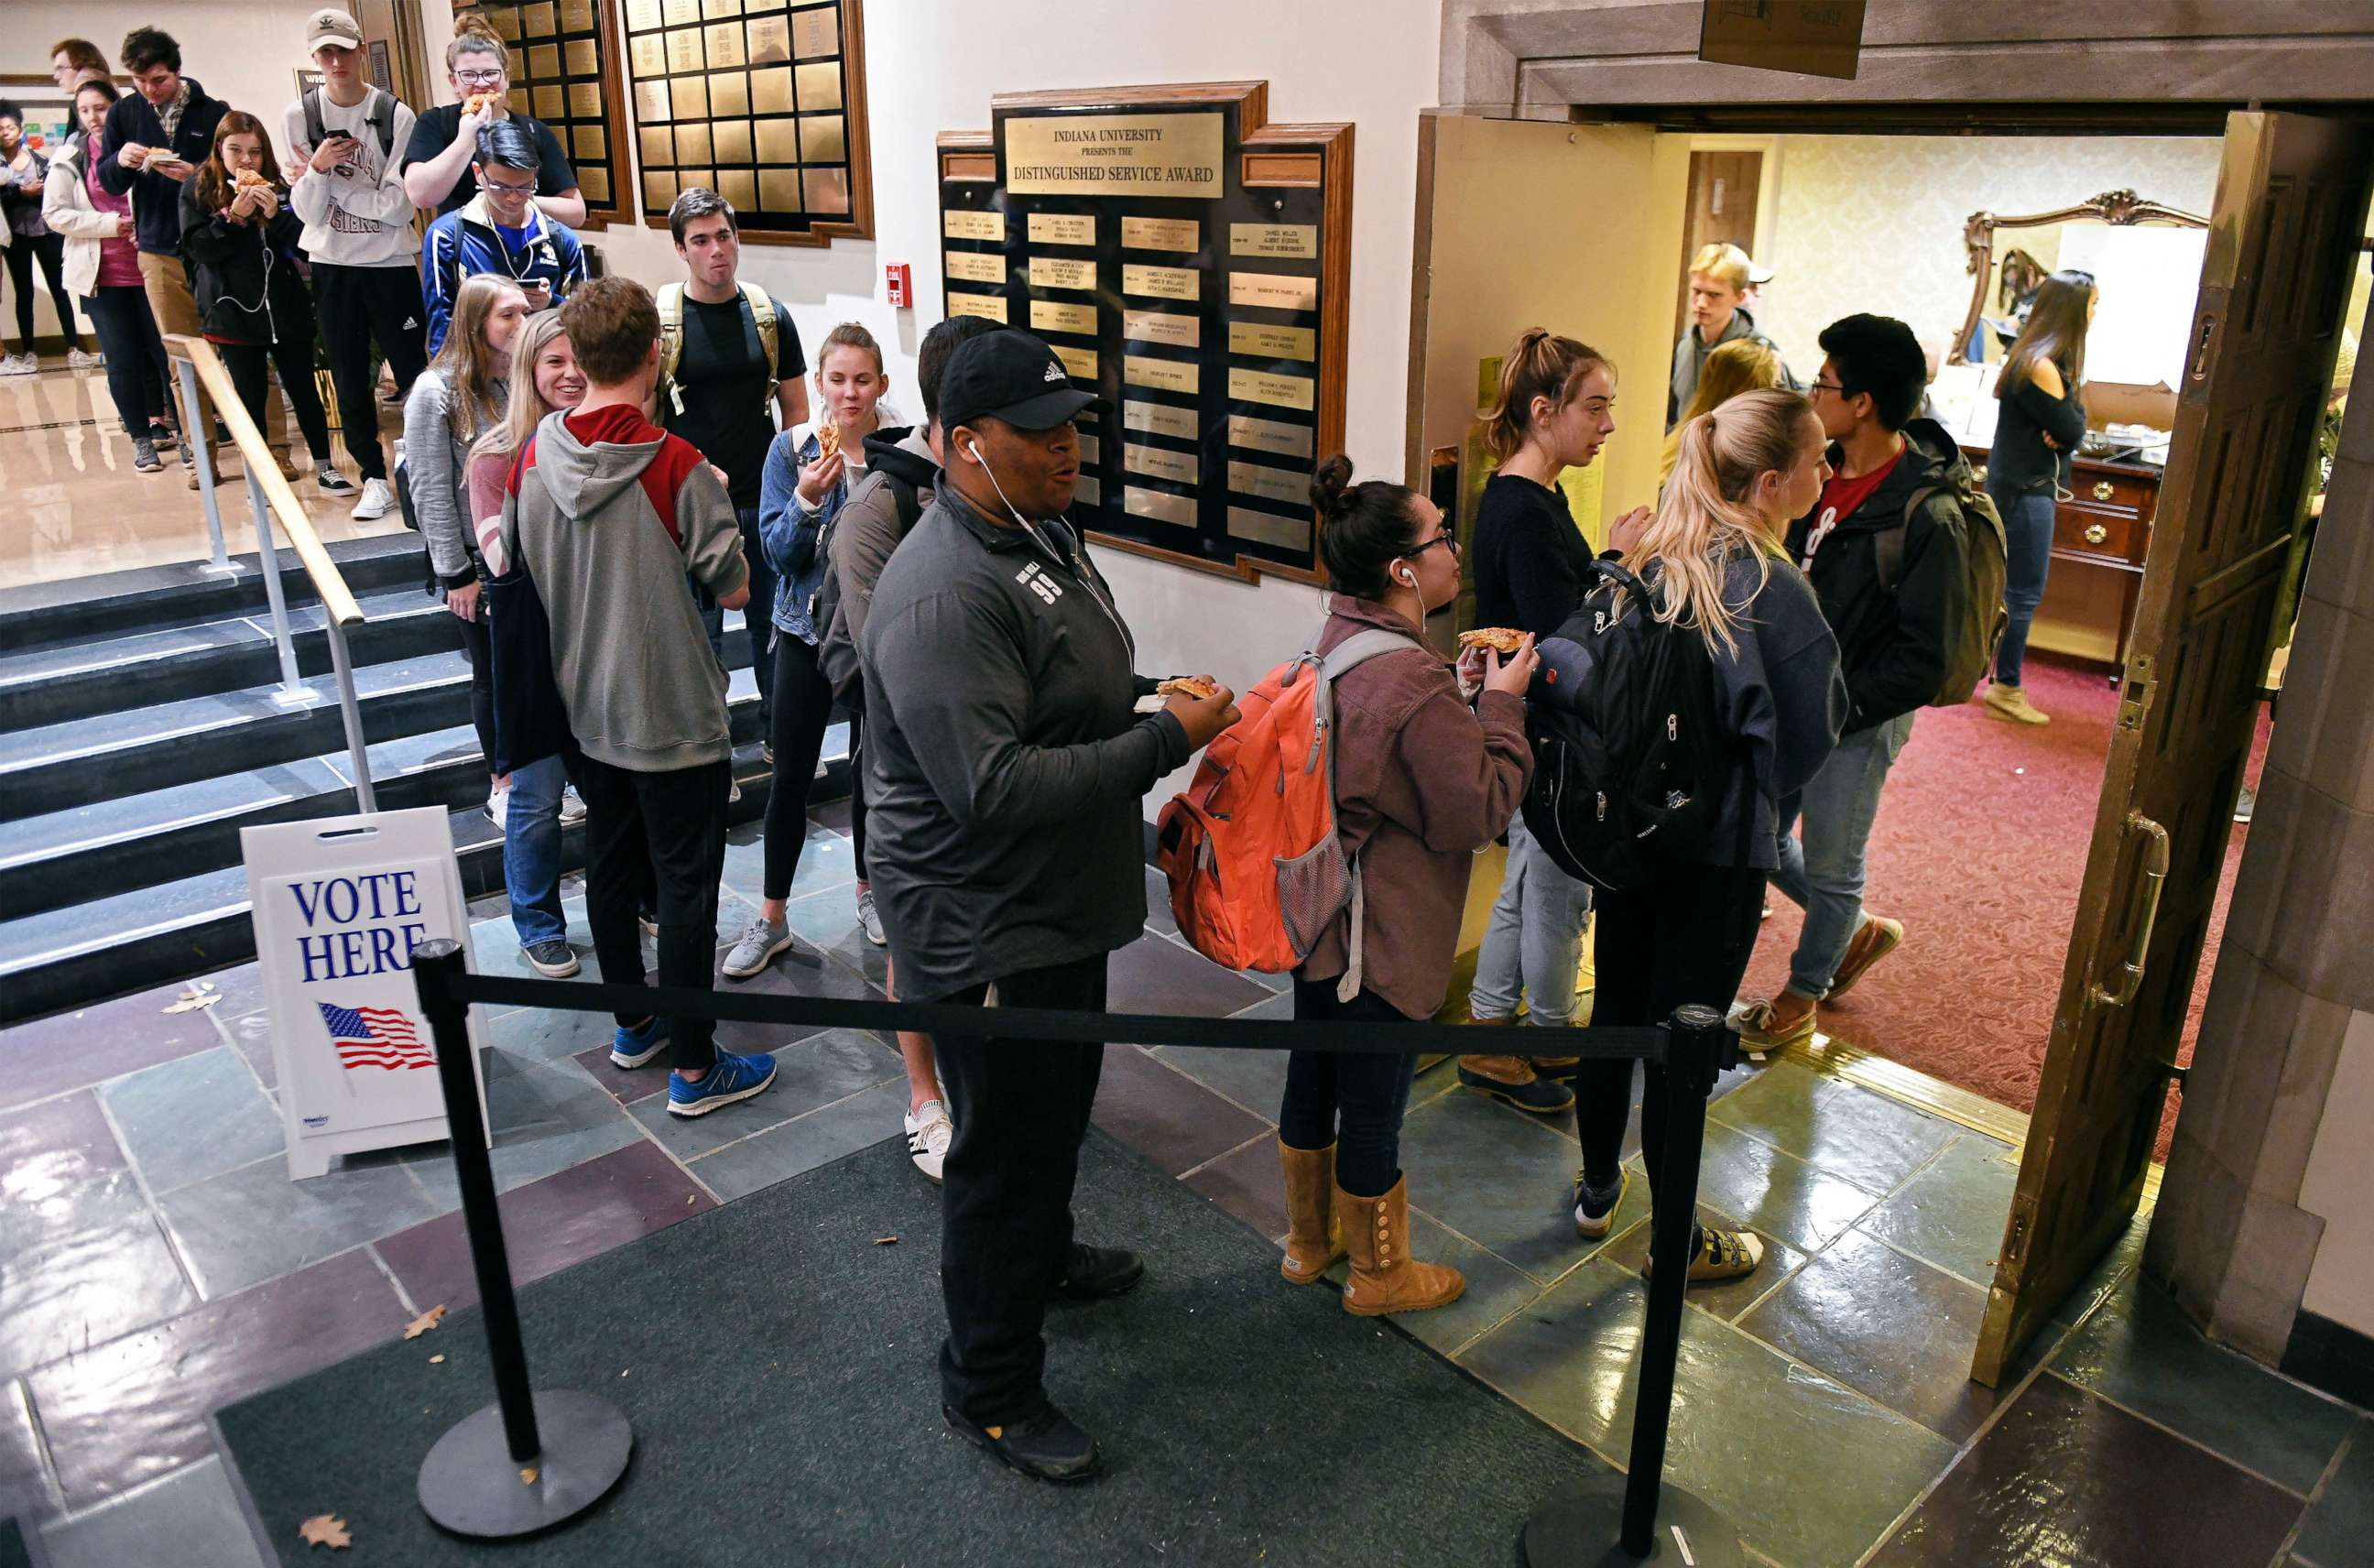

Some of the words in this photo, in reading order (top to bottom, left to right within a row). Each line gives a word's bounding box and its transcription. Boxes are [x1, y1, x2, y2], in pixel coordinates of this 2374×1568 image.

[1054, 130, 1096, 143] INDIANA
[1099, 128, 1164, 142] UNIVERSITY
[1081, 147, 1116, 157] PRESENTS
[1117, 147, 1134, 156] THE
[1014, 166, 1105, 181] DISTINGUISHED
[1107, 167, 1162, 182] SERVICE
[1165, 167, 1214, 183] AWARD
[1029, 572, 1063, 605] 99
[287, 870, 421, 928] VOTE
